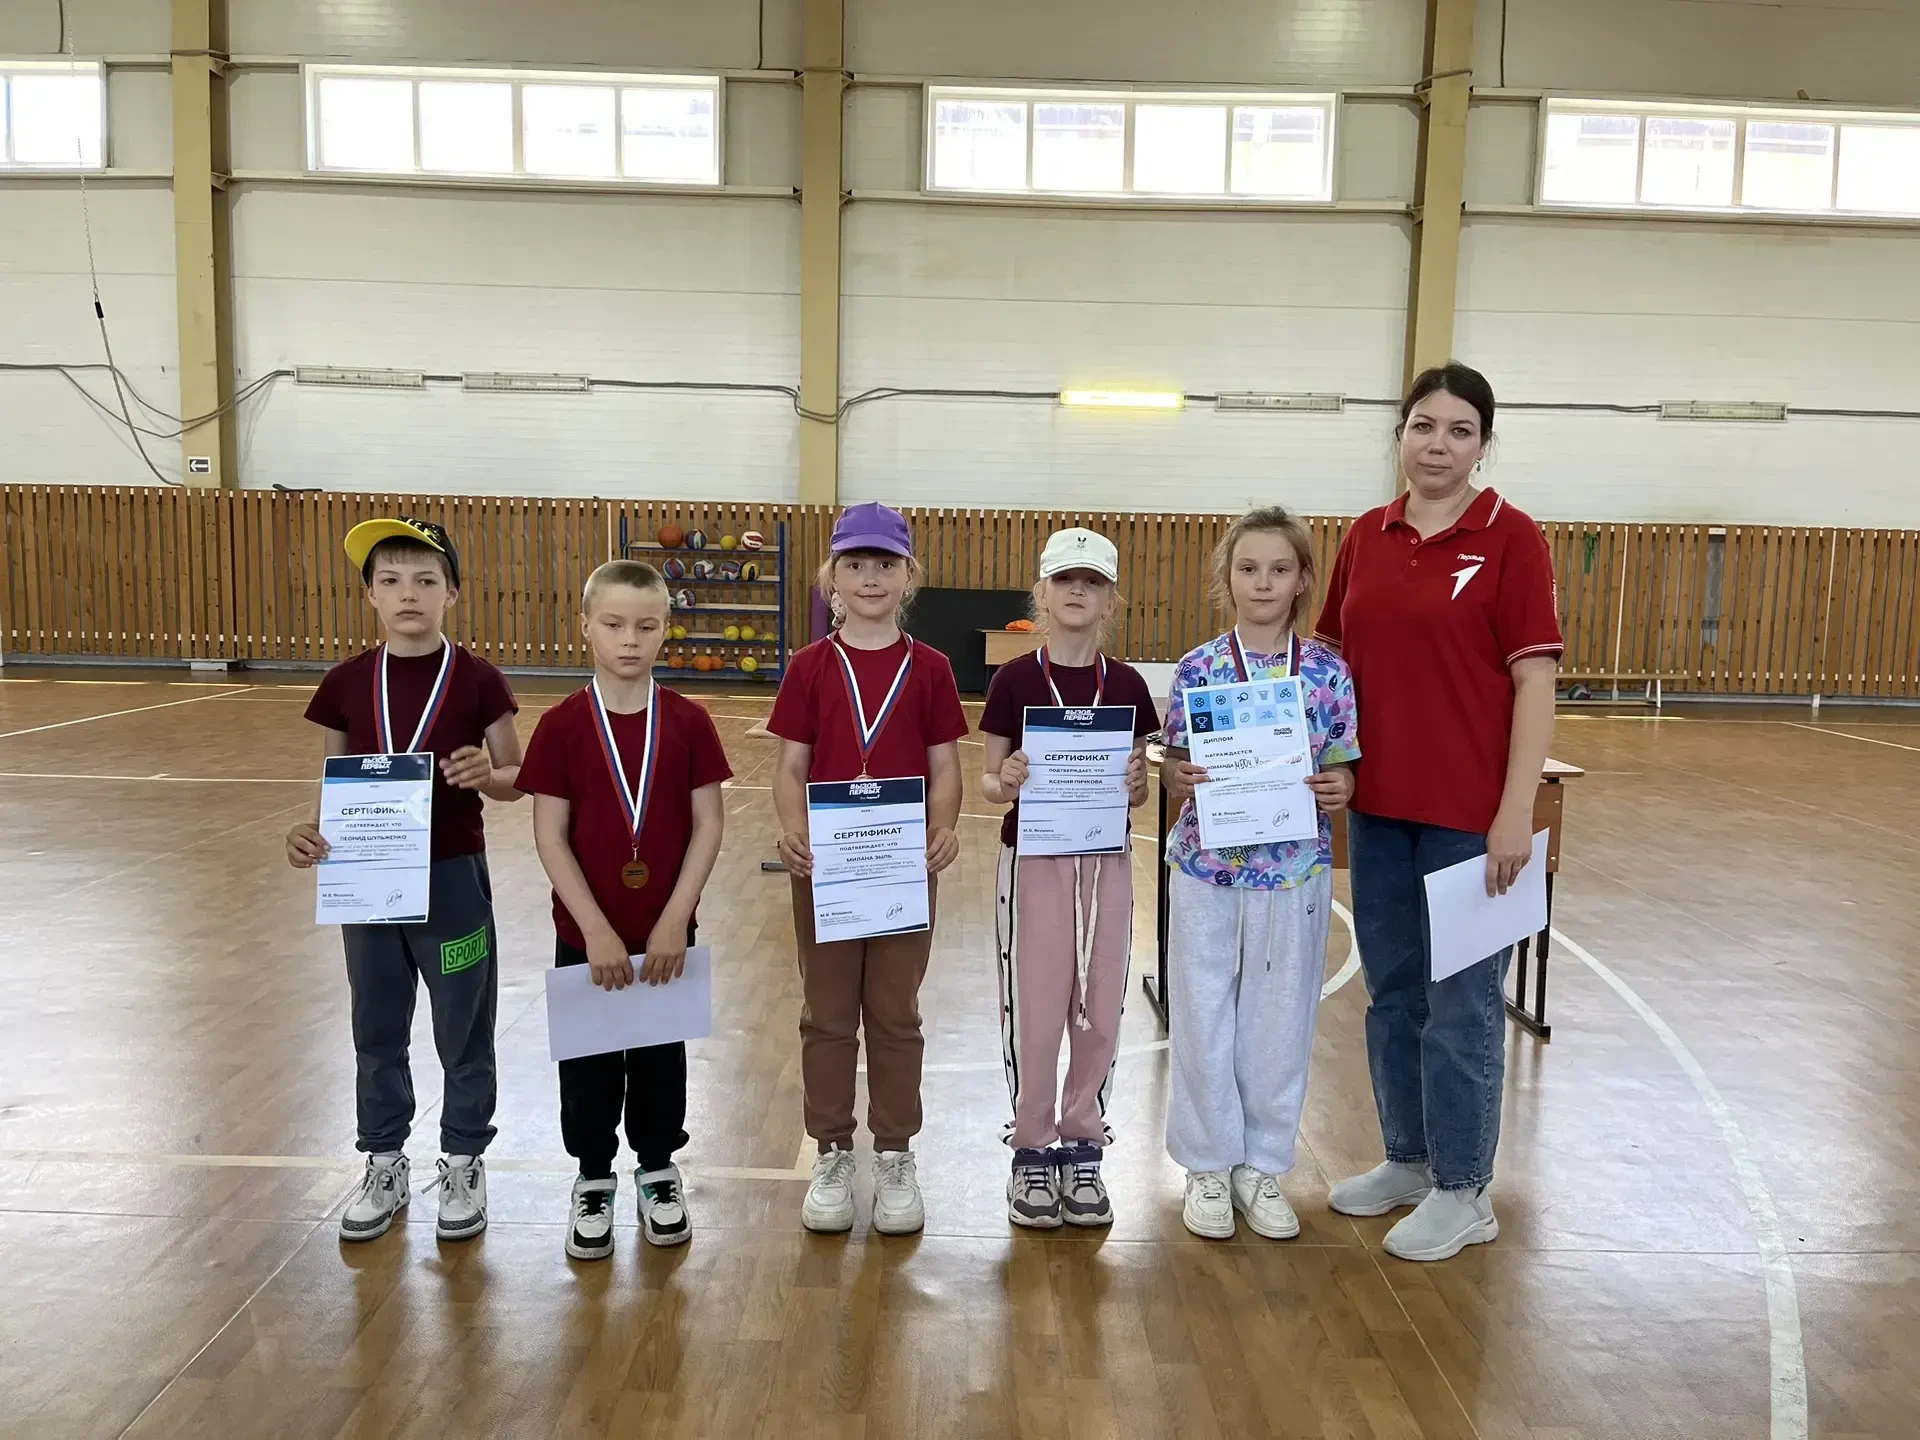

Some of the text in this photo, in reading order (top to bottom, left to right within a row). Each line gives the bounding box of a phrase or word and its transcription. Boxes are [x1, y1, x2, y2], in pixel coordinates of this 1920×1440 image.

[1063, 713, 1095, 721] ПЕРВЫХ
[1203, 736, 1234, 744] ДИПЛОМ
[1044, 753, 1111, 762] СЕРТИФИКАТ
[360, 761, 393, 770] ПЕРВЫХ
[850, 782, 878, 790] ВЫЗОВ
[848, 786, 882, 796] ПЕРВЫХ
[833, 827, 903, 840] СЕРТИФИКАТ
[447, 935, 482, 966] SPORT
